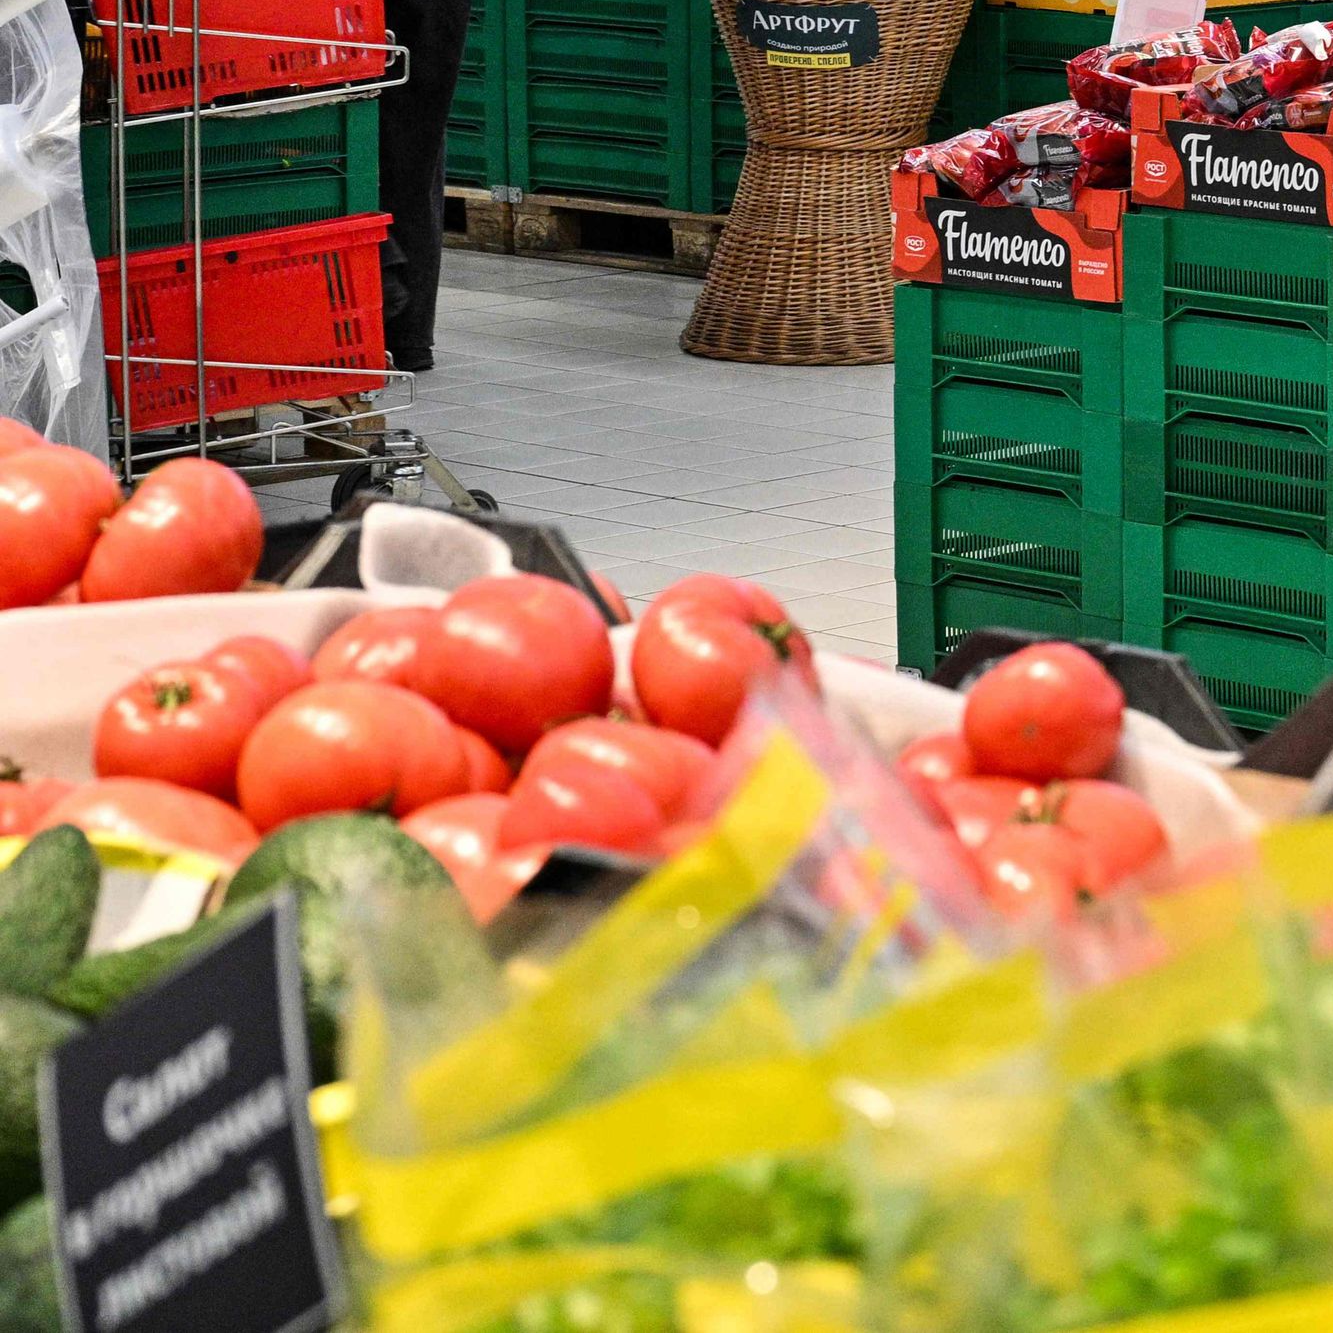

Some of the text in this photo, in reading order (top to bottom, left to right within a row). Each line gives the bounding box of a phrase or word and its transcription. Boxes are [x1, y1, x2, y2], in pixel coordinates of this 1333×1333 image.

[767, 39, 849, 53] создано природой
[1181, 132, 1319, 193] Flamenco
[1191, 193, 1317, 215] НАСТОЯЩИЕ КРАСНЫЕ ТОМАТЫ
[905, 237, 926, 248] РОСТ
[937, 209, 1066, 267] Flamenco
[947, 267, 1063, 289] НАСТОЯЩИЕ КРАСНЫЕ ТОМАТЫ
